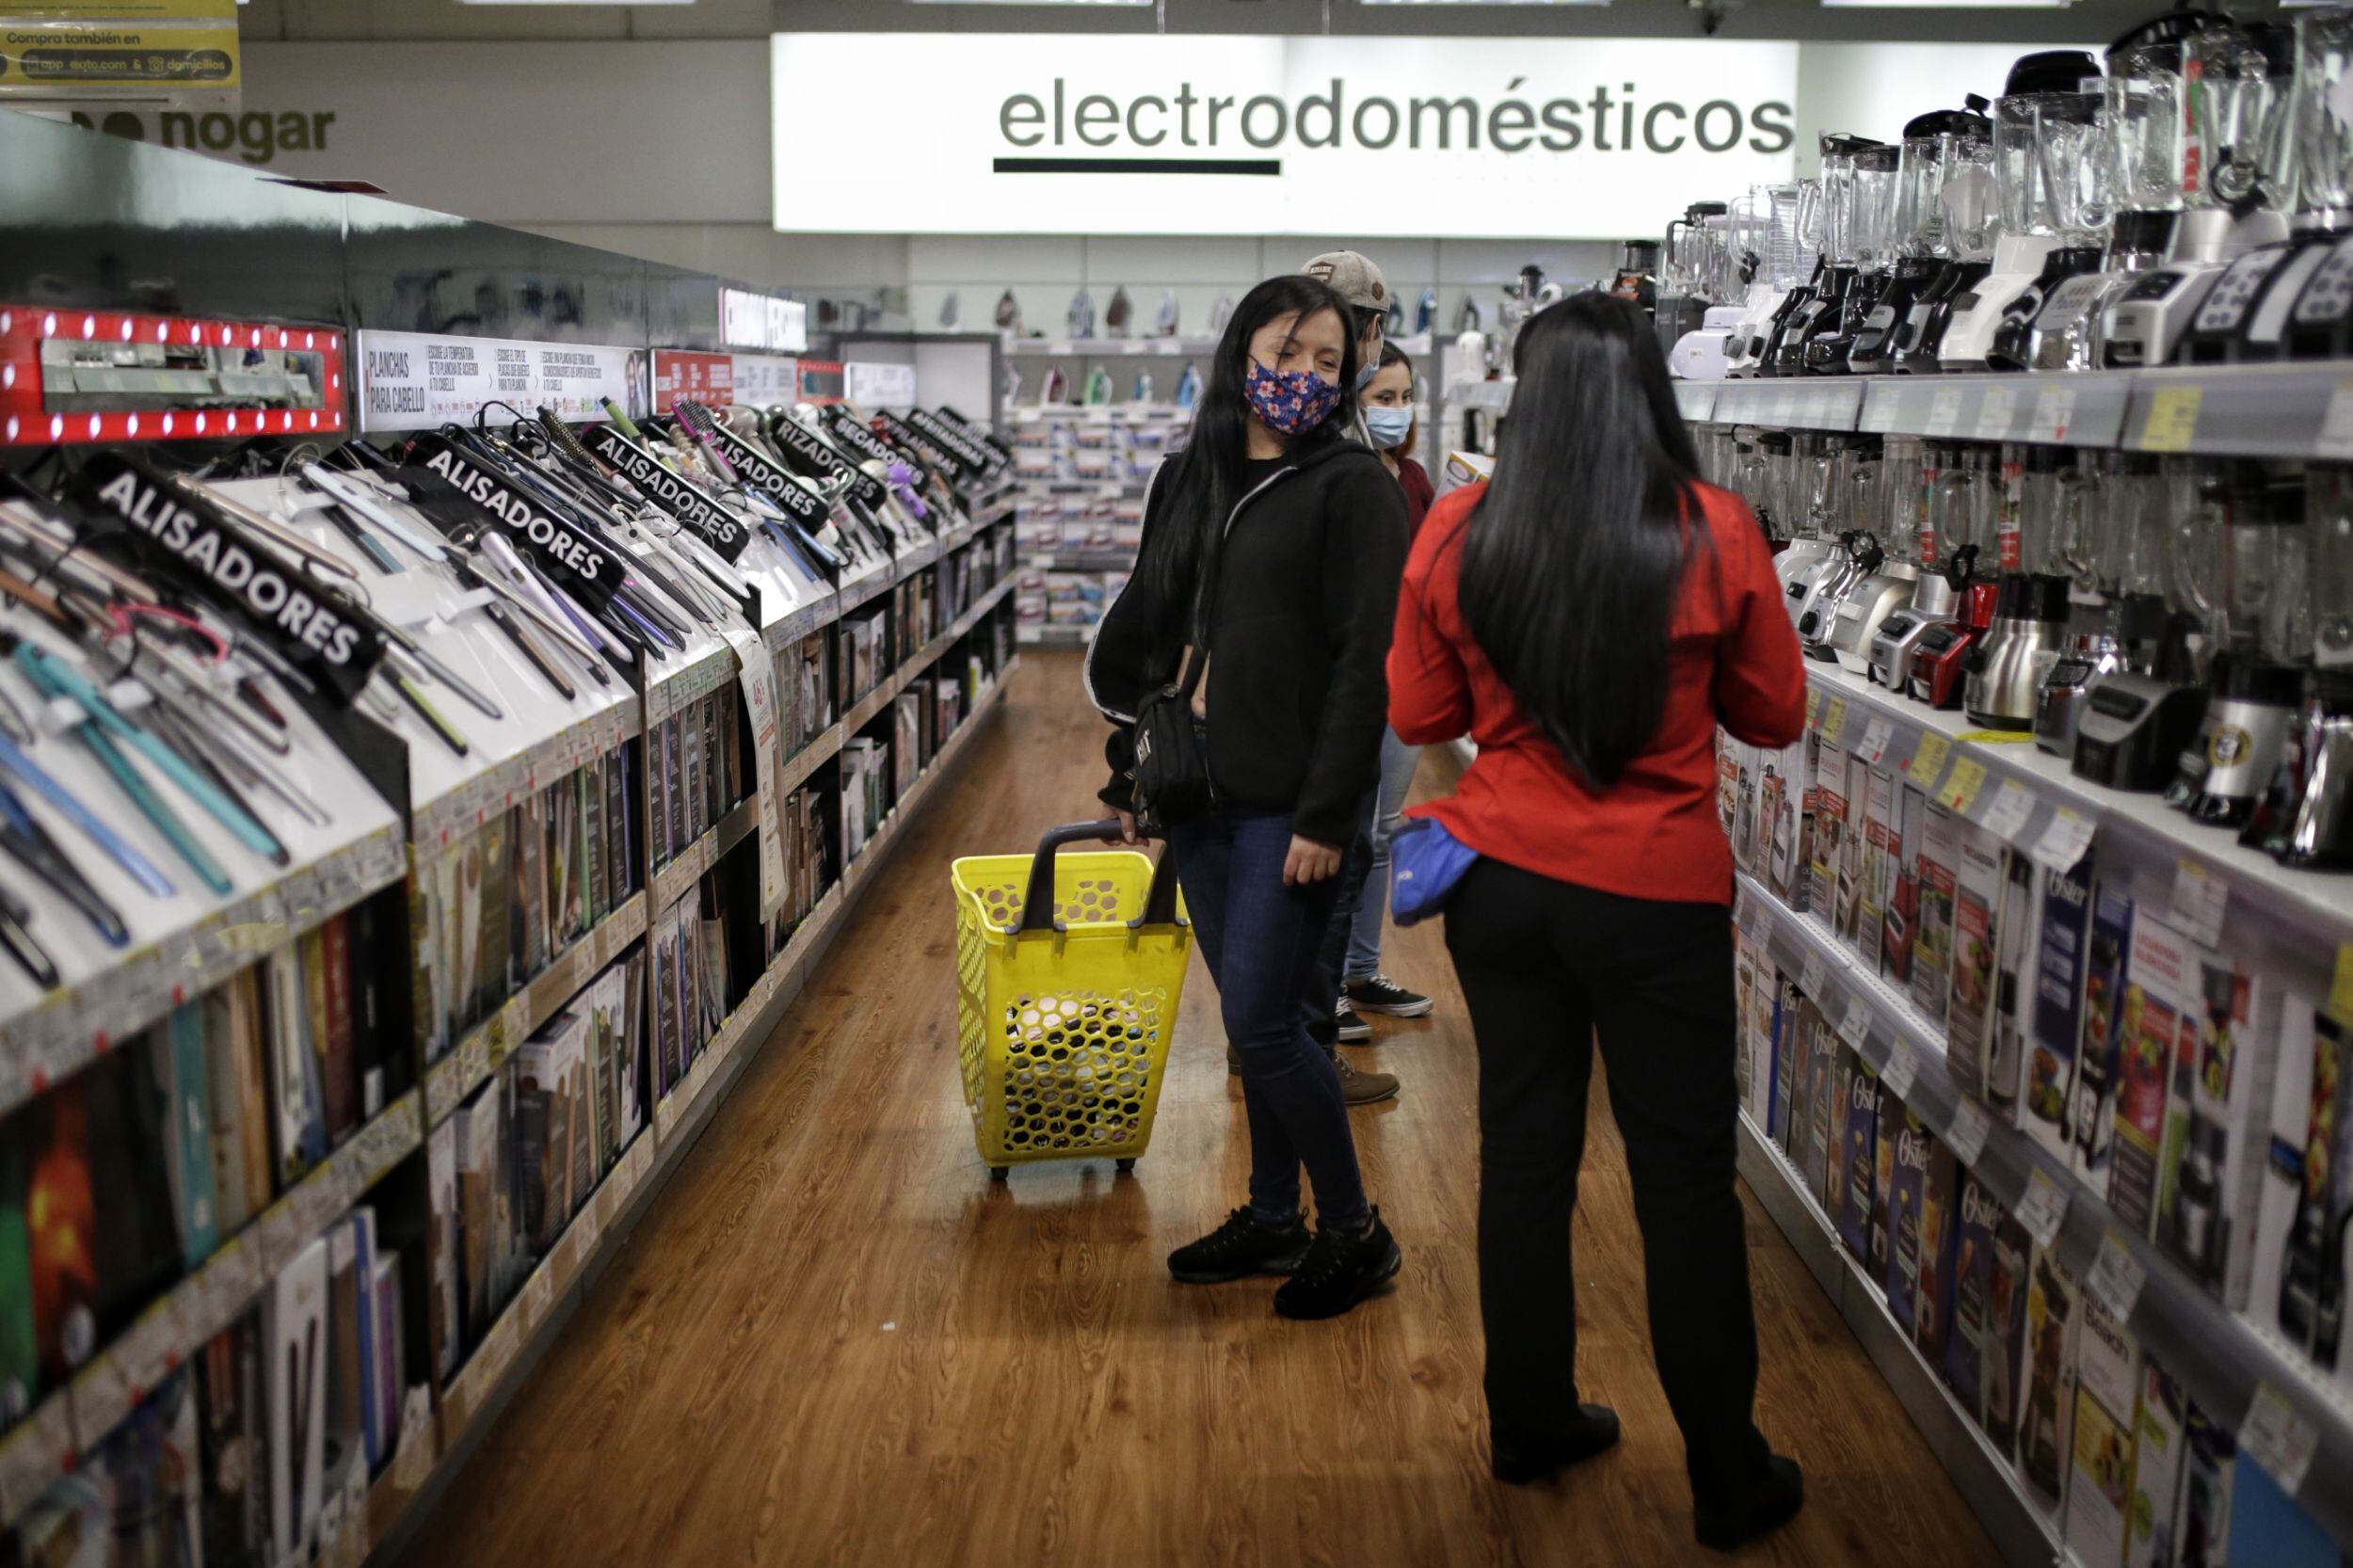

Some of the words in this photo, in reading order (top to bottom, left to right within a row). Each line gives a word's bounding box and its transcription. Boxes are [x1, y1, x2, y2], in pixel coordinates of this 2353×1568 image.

[7, 32, 62, 45] Compra
[64, 31, 121, 44] también
[123, 34, 140, 44] en
[40, 60, 64, 72] app
[998, 76, 1797, 154] electrodomésticos
[369, 351, 409, 378] PLANCHAS
[370, 387, 392, 413] PARA
[392, 387, 425, 413] CABELLO
[596, 437, 738, 543] ALISADORES
[710, 435, 816, 517] ISADORES
[776, 421, 878, 500] RIZADOES
[426, 449, 604, 580] ALISADORES
[99, 472, 360, 664] ALISADORES
